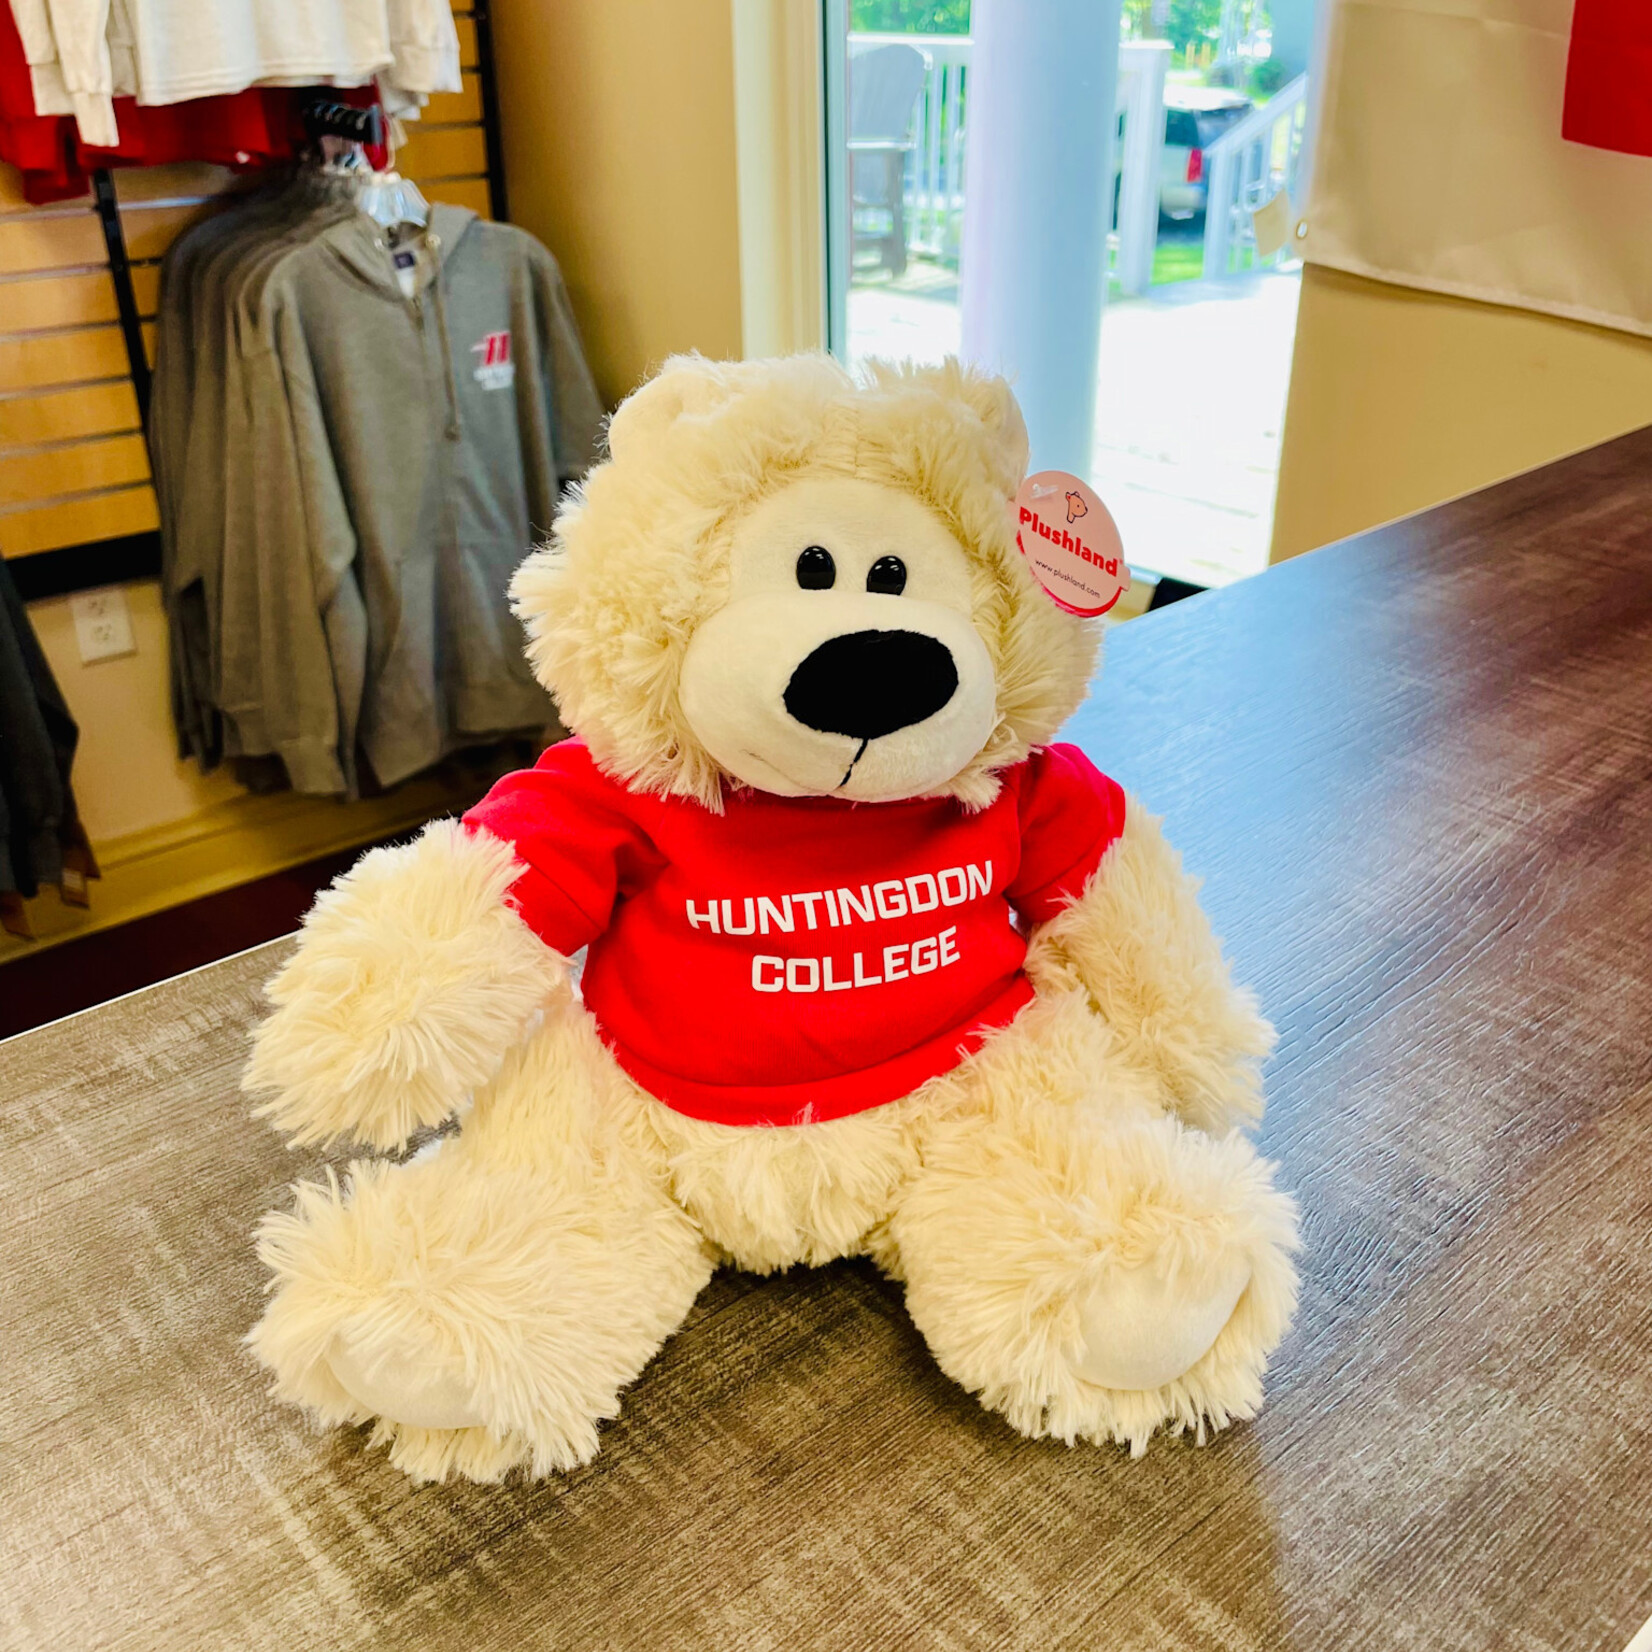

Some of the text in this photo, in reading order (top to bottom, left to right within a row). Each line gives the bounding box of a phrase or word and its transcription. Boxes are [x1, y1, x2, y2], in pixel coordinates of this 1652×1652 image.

[1019, 506, 1118, 577] Plushland
[1035, 560, 1100, 598] www.plushland.com
[686, 860, 993, 936] HUNTINGDON
[752, 926, 961, 993] COLLEGE
